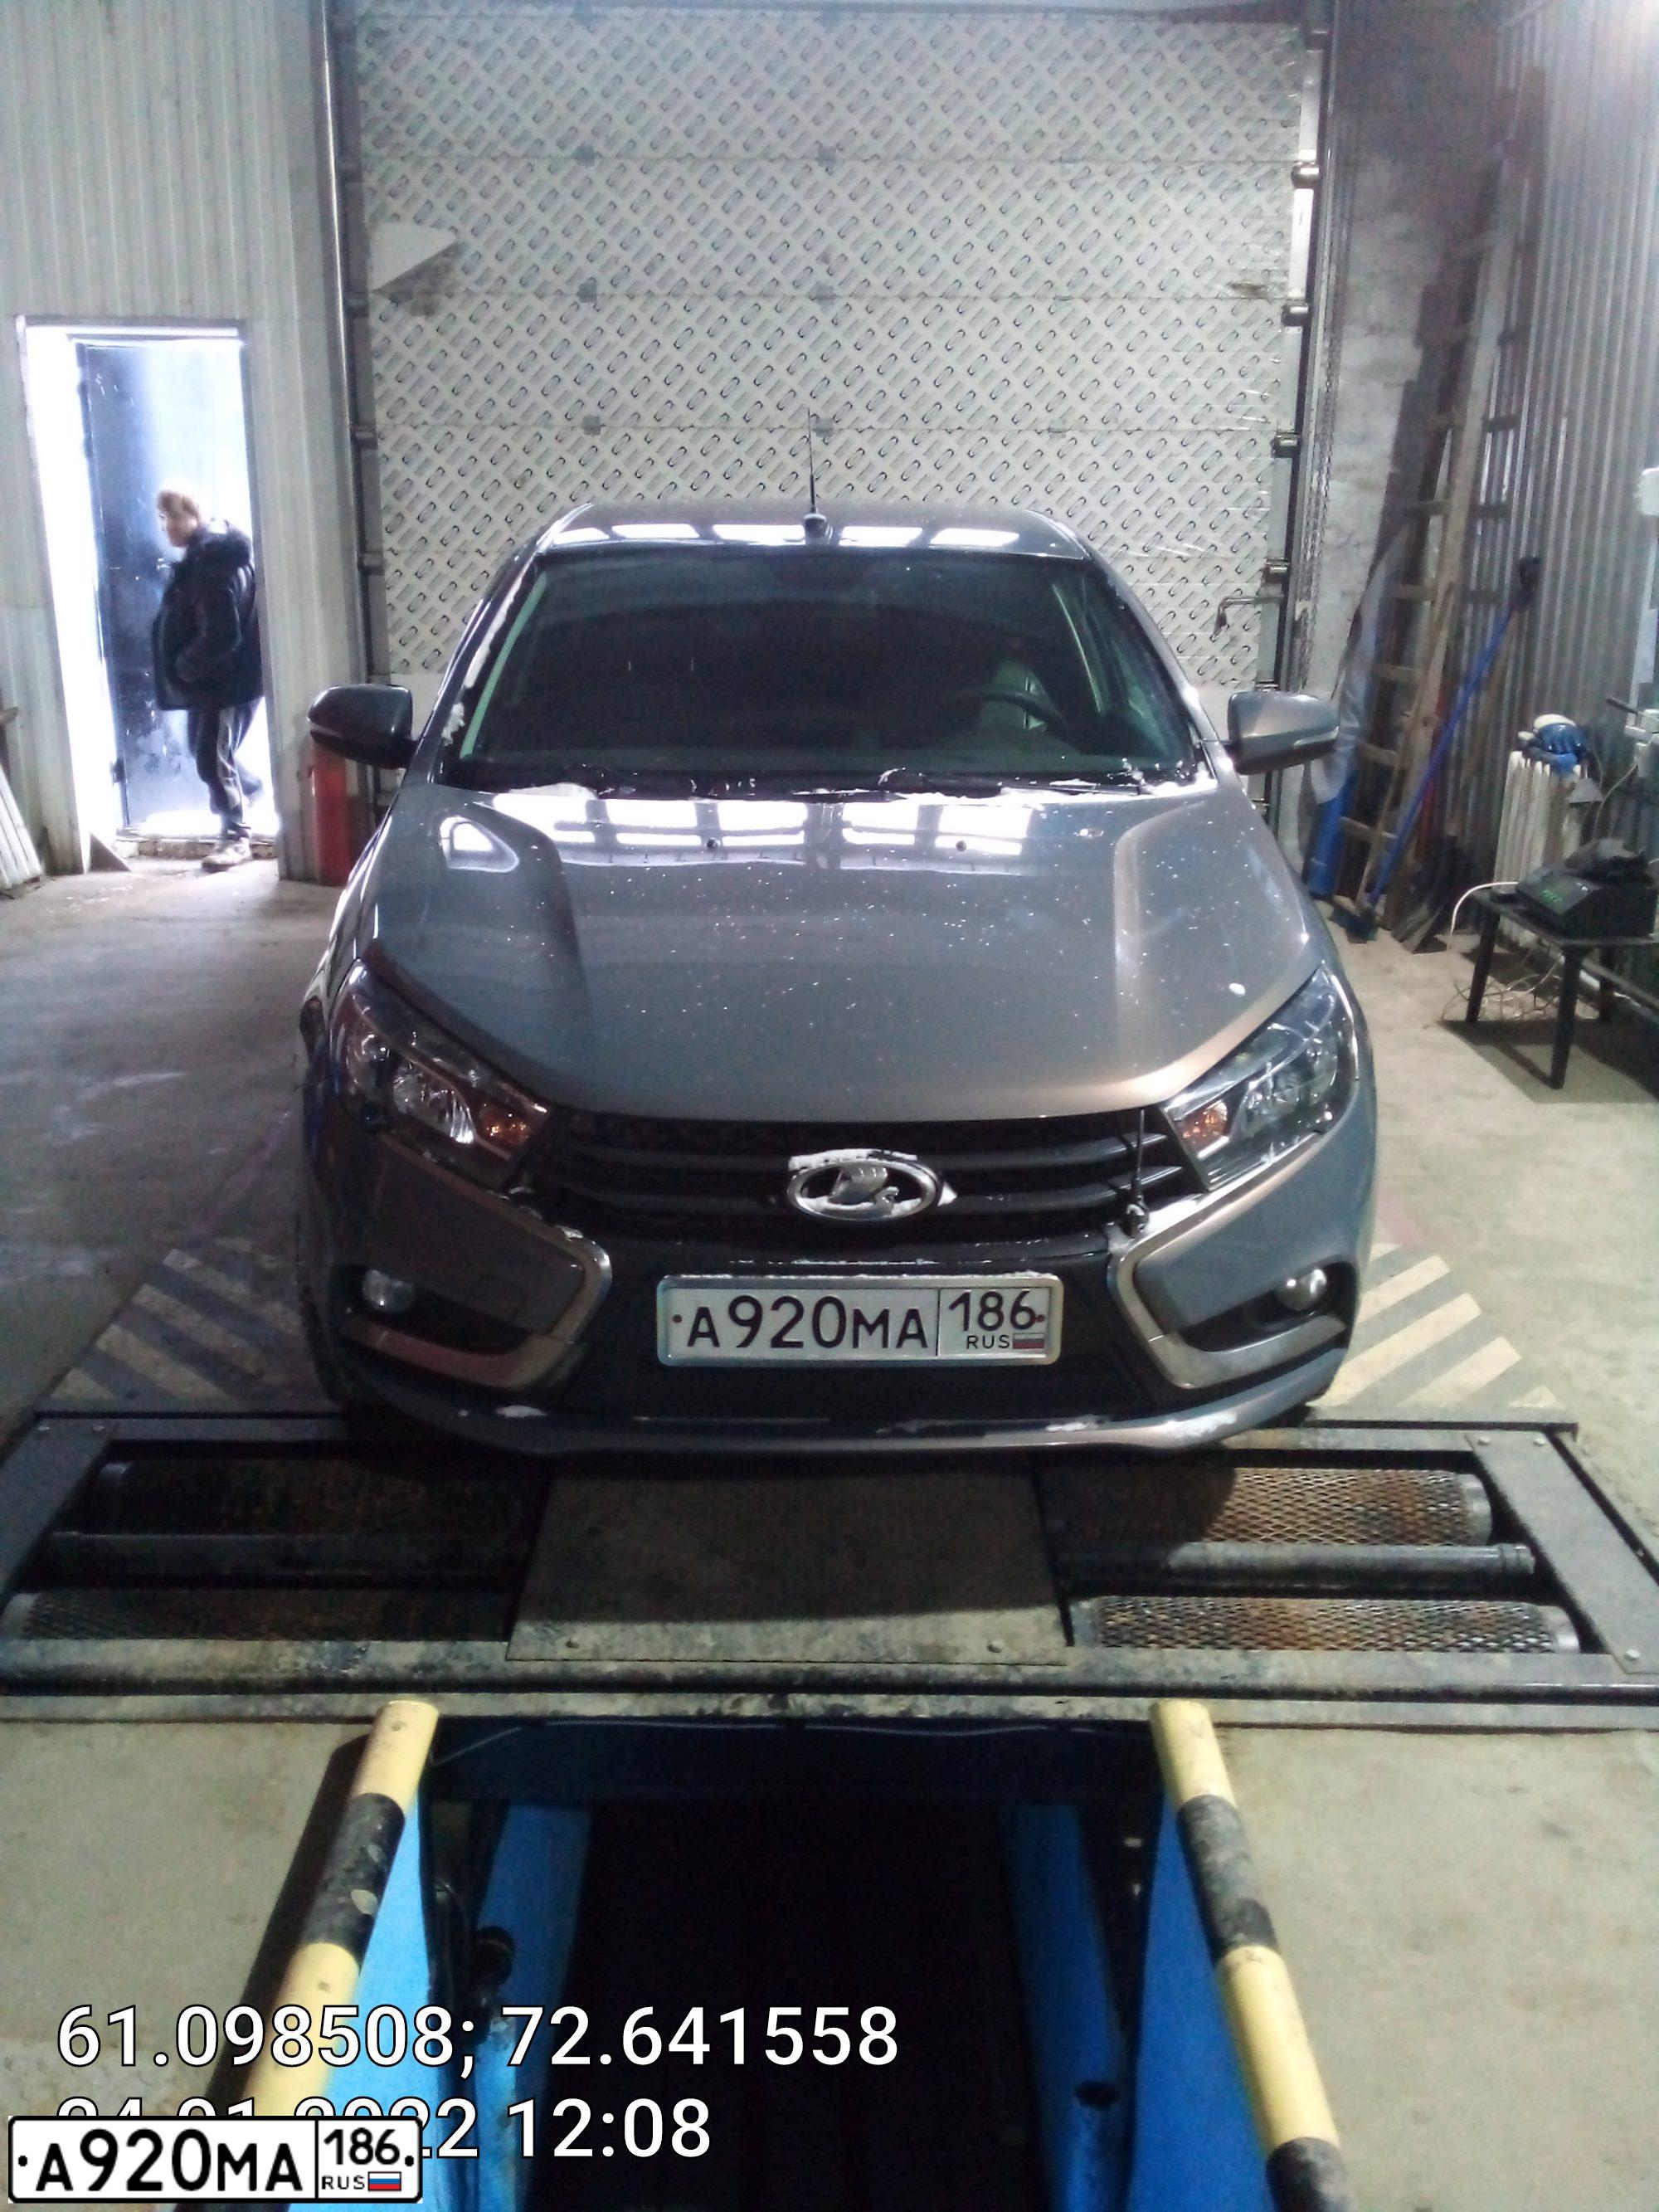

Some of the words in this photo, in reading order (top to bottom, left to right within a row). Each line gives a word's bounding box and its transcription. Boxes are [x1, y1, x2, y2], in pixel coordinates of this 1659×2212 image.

[687, 1295, 928, 1349] А920МА
[948, 1289, 1036, 1333] 186
[966, 1334, 1011, 1351] RUS
